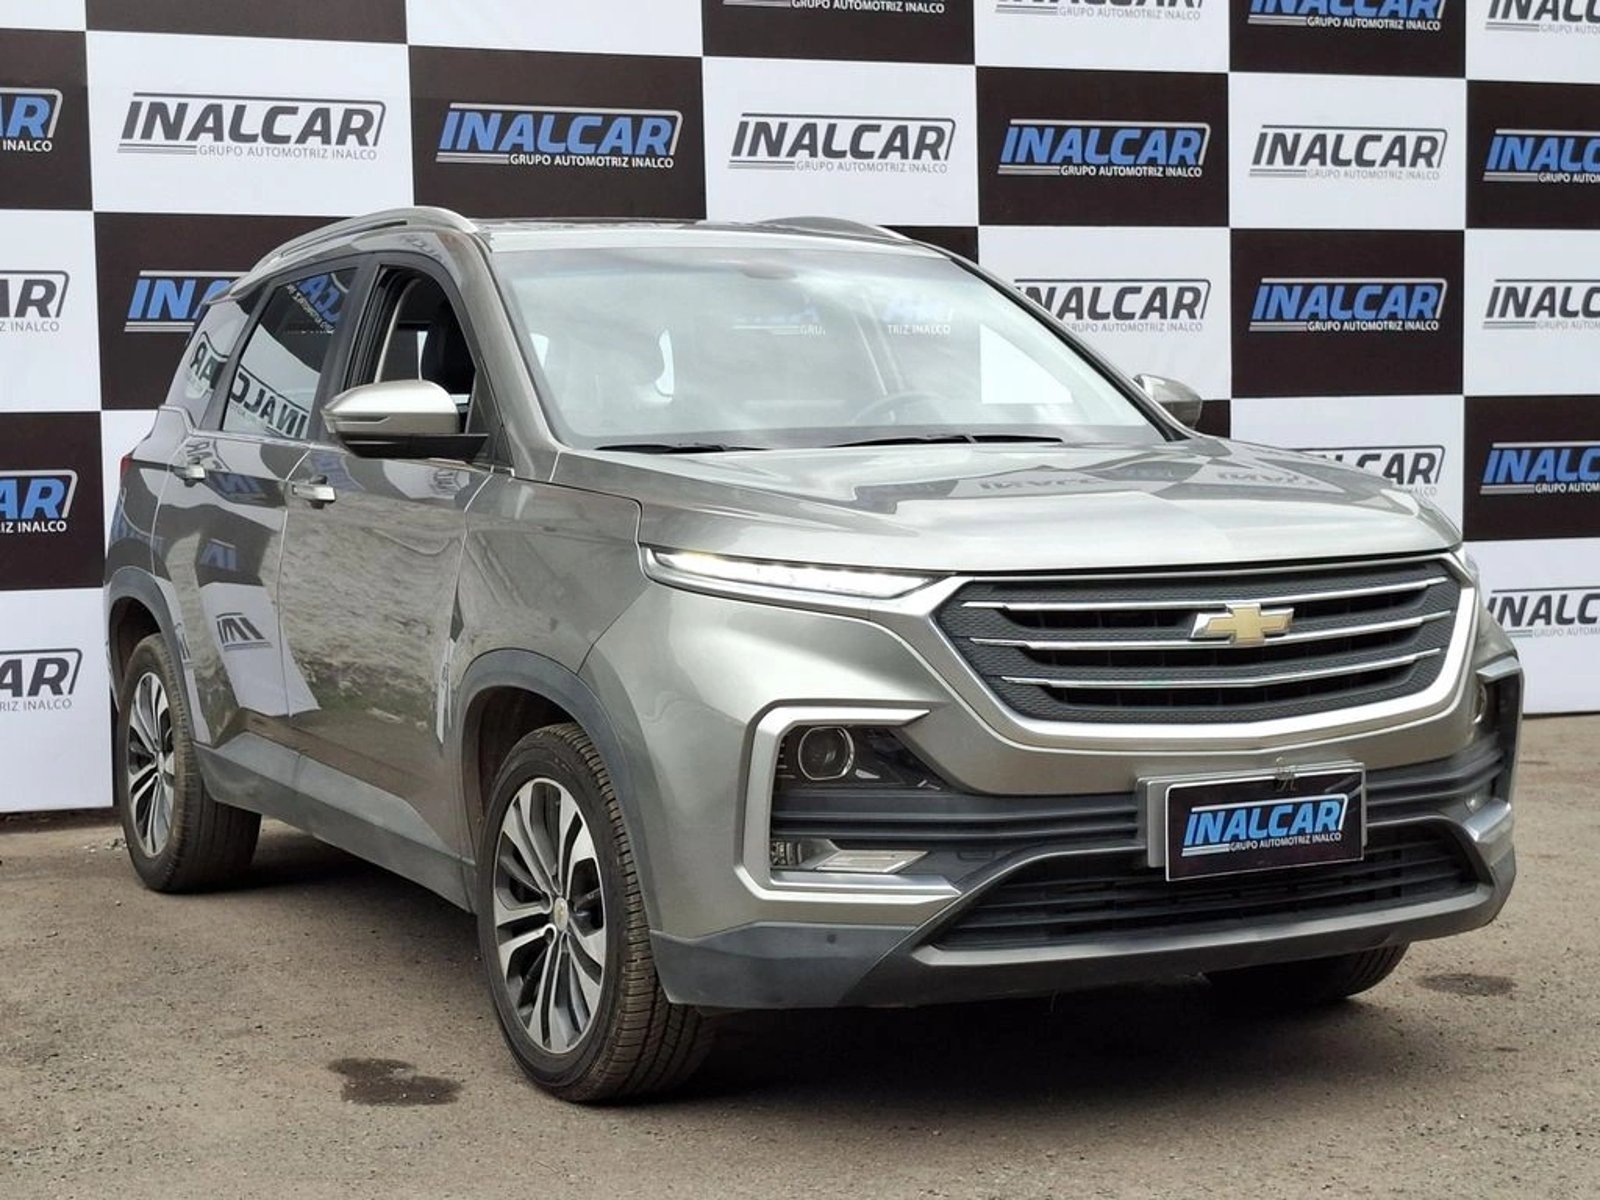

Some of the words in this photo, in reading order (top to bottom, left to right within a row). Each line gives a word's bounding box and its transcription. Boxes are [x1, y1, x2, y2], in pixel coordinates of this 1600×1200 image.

[792, 0, 830, 9] GRUPO
[833, 0, 903, 12] AUTOMOTRIZ
[905, 3, 945, 13] INALCO
[1307, 17, 1340, 27] GRUPO
[1343, 18, 1403, 29] AUTOMOTRIZ
[1406, 20, 1440, 30] INALCO
[121, 101, 375, 146] INALCAR
[438, 111, 672, 155] INALCAR
[731, 120, 946, 161] INALCAR
[2, 139, 53, 152] INALCO
[199, 145, 243, 157] GRUPO
[247, 146, 328, 159] AUTOMOTRIZ
[332, 148, 377, 160] INALCO
[1000, 126, 1201, 165] INALCAR
[1252, 132, 1439, 168] INALCAR
[510, 153, 551, 166] GRUPO
[554, 154, 629, 168] AUTOMOTRIZ
[632, 157, 674, 168] INALCO
[796, 160, 835, 172] GRUPO
[837, 161, 906, 173] AUTOMOTRIZ
[909, 162, 948, 174] INALCO
[1061, 165, 1096, 176] GRUPO
[1099, 166, 1164, 177] AUTOMOTRIZ
[1165, 167, 1202, 178] INALCO
[1539, 173, 1570, 183] GRUPO
[1572, 173, 1600, 183] AUTO
[1017, 286, 1202, 321] NALCAR
[1252, 285, 1439, 320] INALCAR
[1485, 286, 1600, 319] INALC
[10, 321, 60, 332] INALCO
[1307, 321, 1341, 331] GRUPO
[1342, 321, 1403, 331] AUTOMOTRIZ
[1404, 320, 1439, 331] INALCO
[1482, 448, 1600, 483] INALC
[1535, 484, 1566, 493] GRUPO
[18, 520, 67, 533] INALCO
[23, 698, 73, 712] INALCO
[1183, 800, 1341, 846] INALCAR
[1229, 839, 1258, 851] GRUPO
[1259, 835, 1311, 849] AUTOMOTRIZ
[1312, 832, 1342, 844] INALCO
